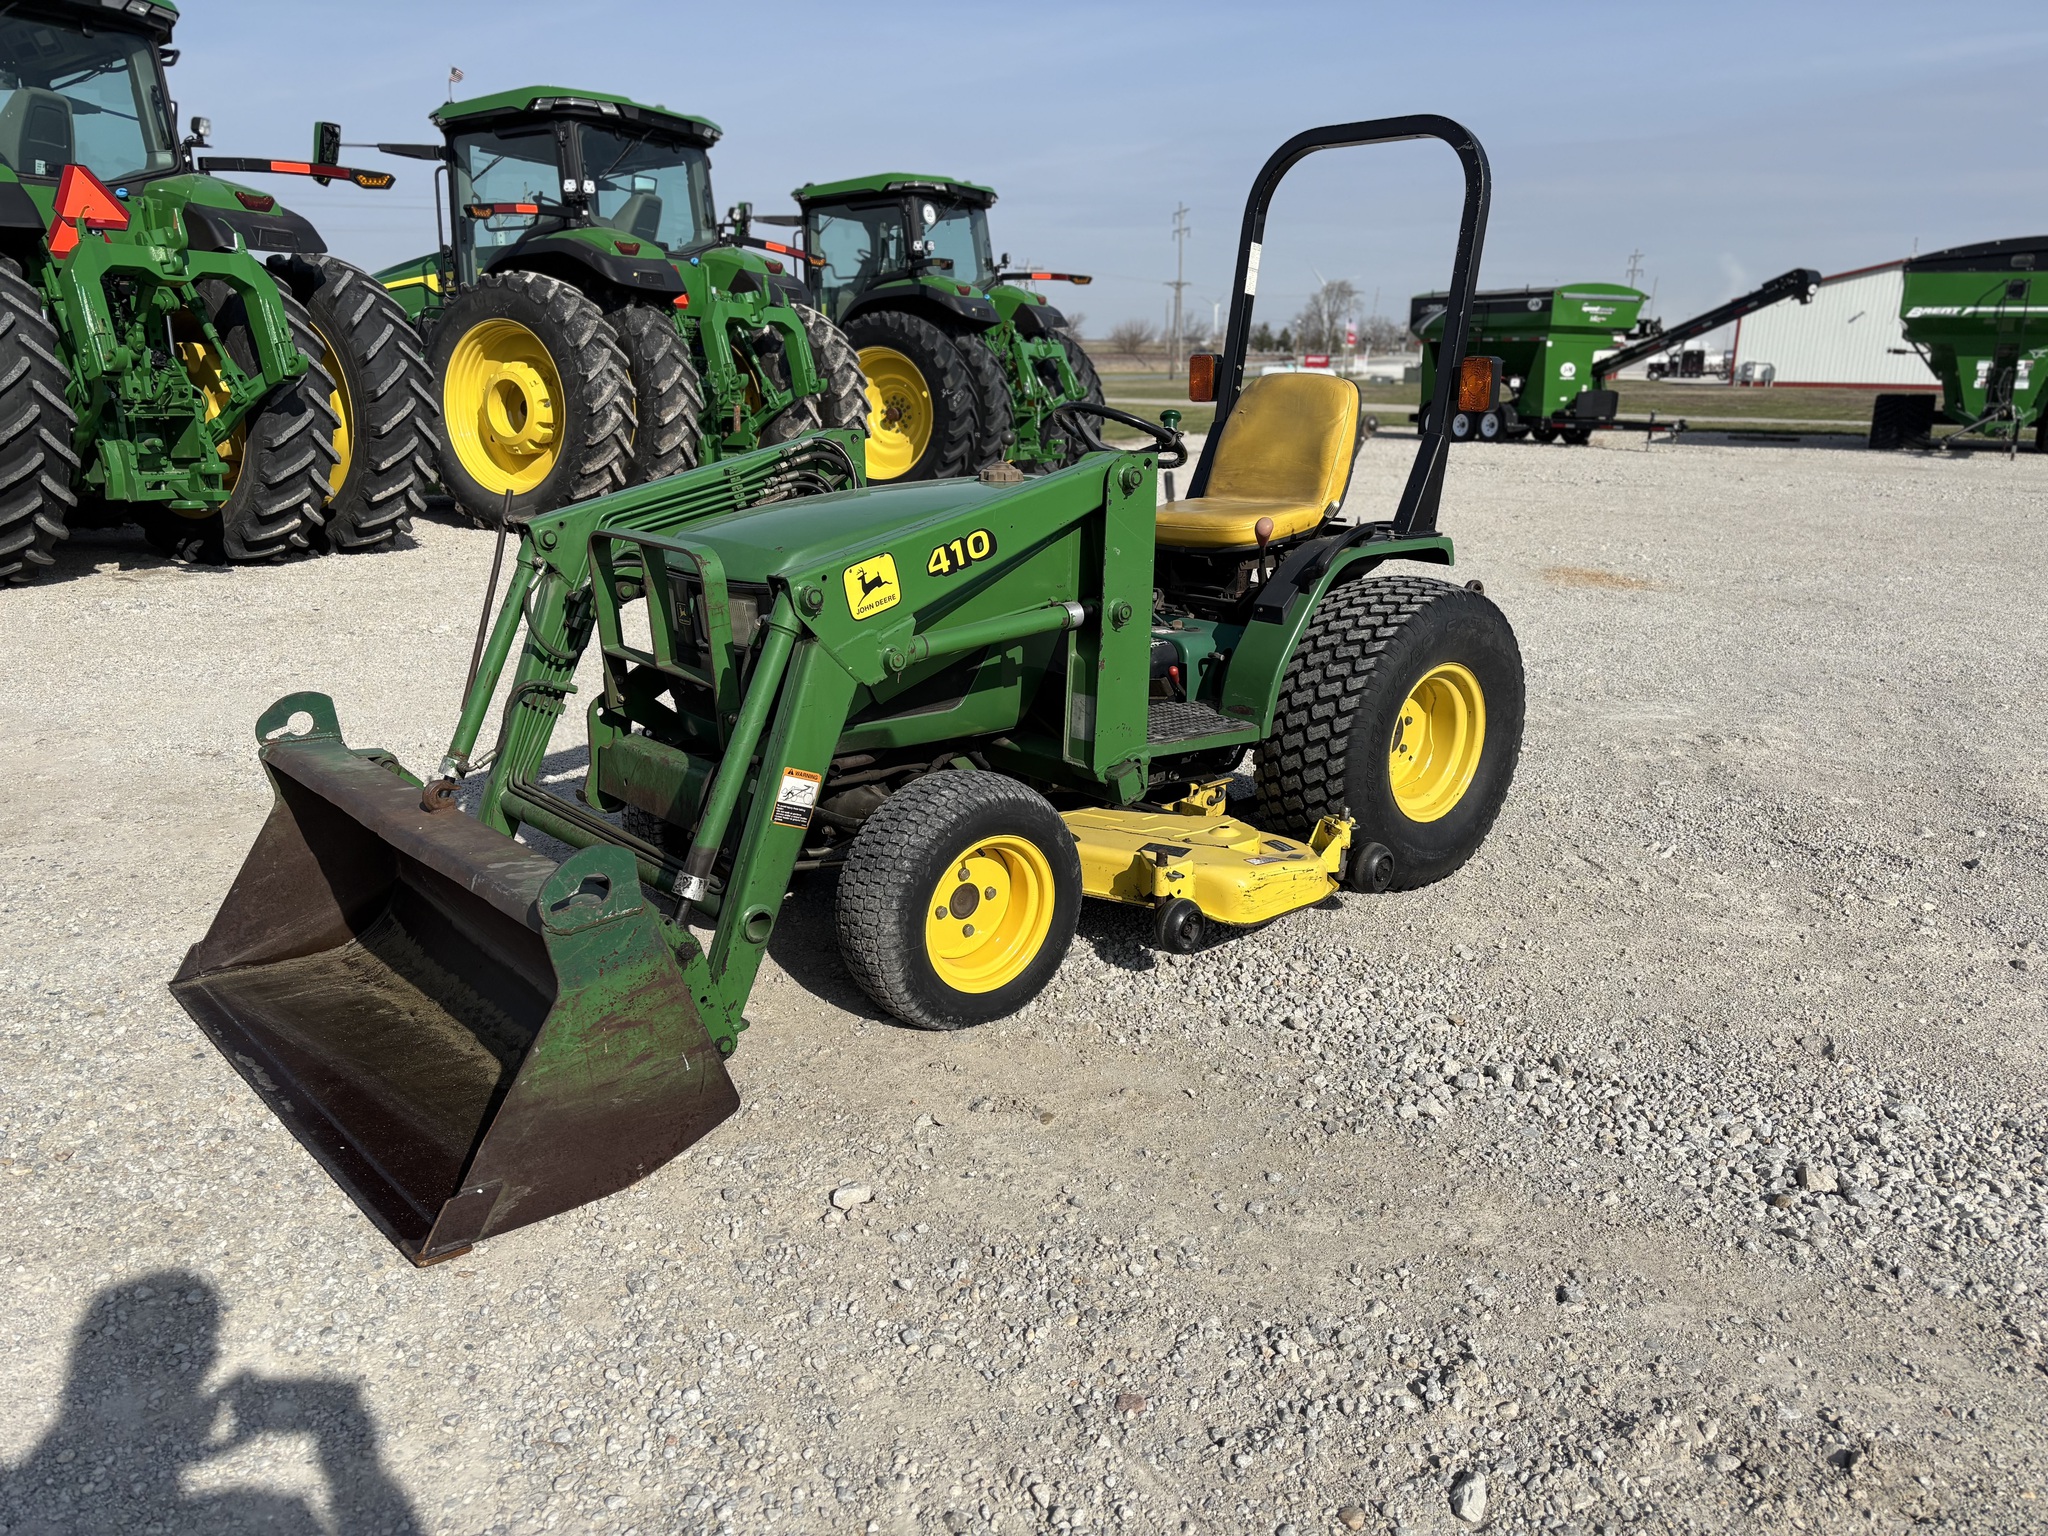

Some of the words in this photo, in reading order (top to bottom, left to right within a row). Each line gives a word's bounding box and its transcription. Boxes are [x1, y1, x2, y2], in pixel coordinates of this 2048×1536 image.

[1905, 306, 1961, 318] BRENT
[927, 529, 995, 576] 410
[856, 603, 875, 616] JOHN
[875, 593, 897, 608] DEERE
[794, 771, 819, 780] WARNING
